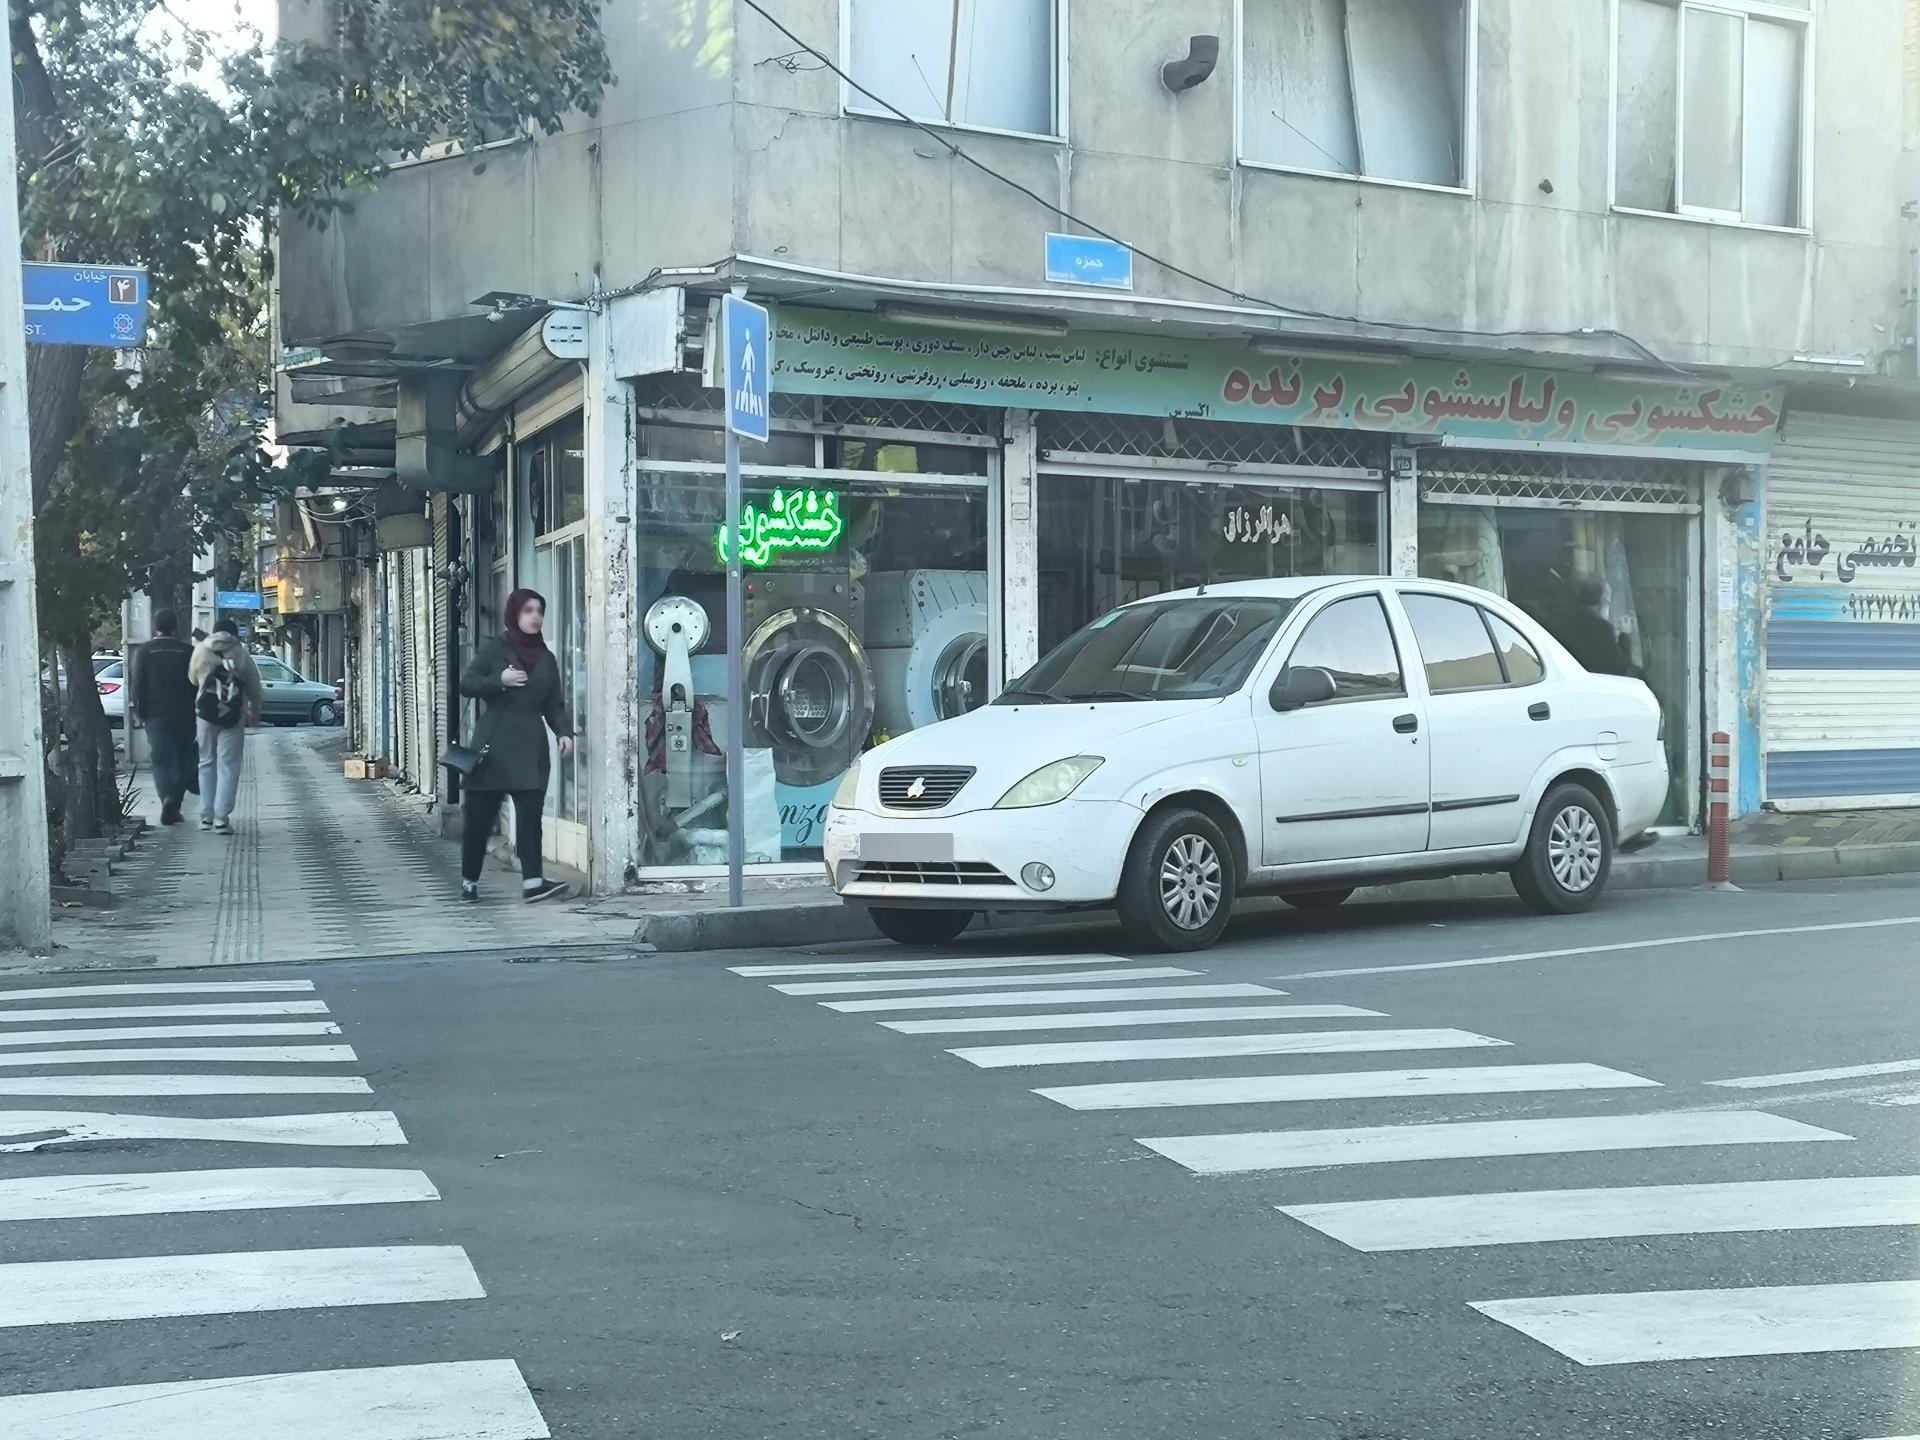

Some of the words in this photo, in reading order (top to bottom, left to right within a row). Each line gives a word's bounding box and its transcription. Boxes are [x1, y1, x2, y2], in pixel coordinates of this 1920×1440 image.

[74, 270, 108, 284] خیابان
[1075, 255, 1104, 269] حمزه
[24, 295, 92, 312] حم
[116, 279, 131, 301] ۴
[1222, 356, 1344, 427] پرنده
[1583, 387, 1779, 444] خشکشویی
[1776, 516, 1831, 582] جامع
[1837, 521, 1917, 583] تخصصی
